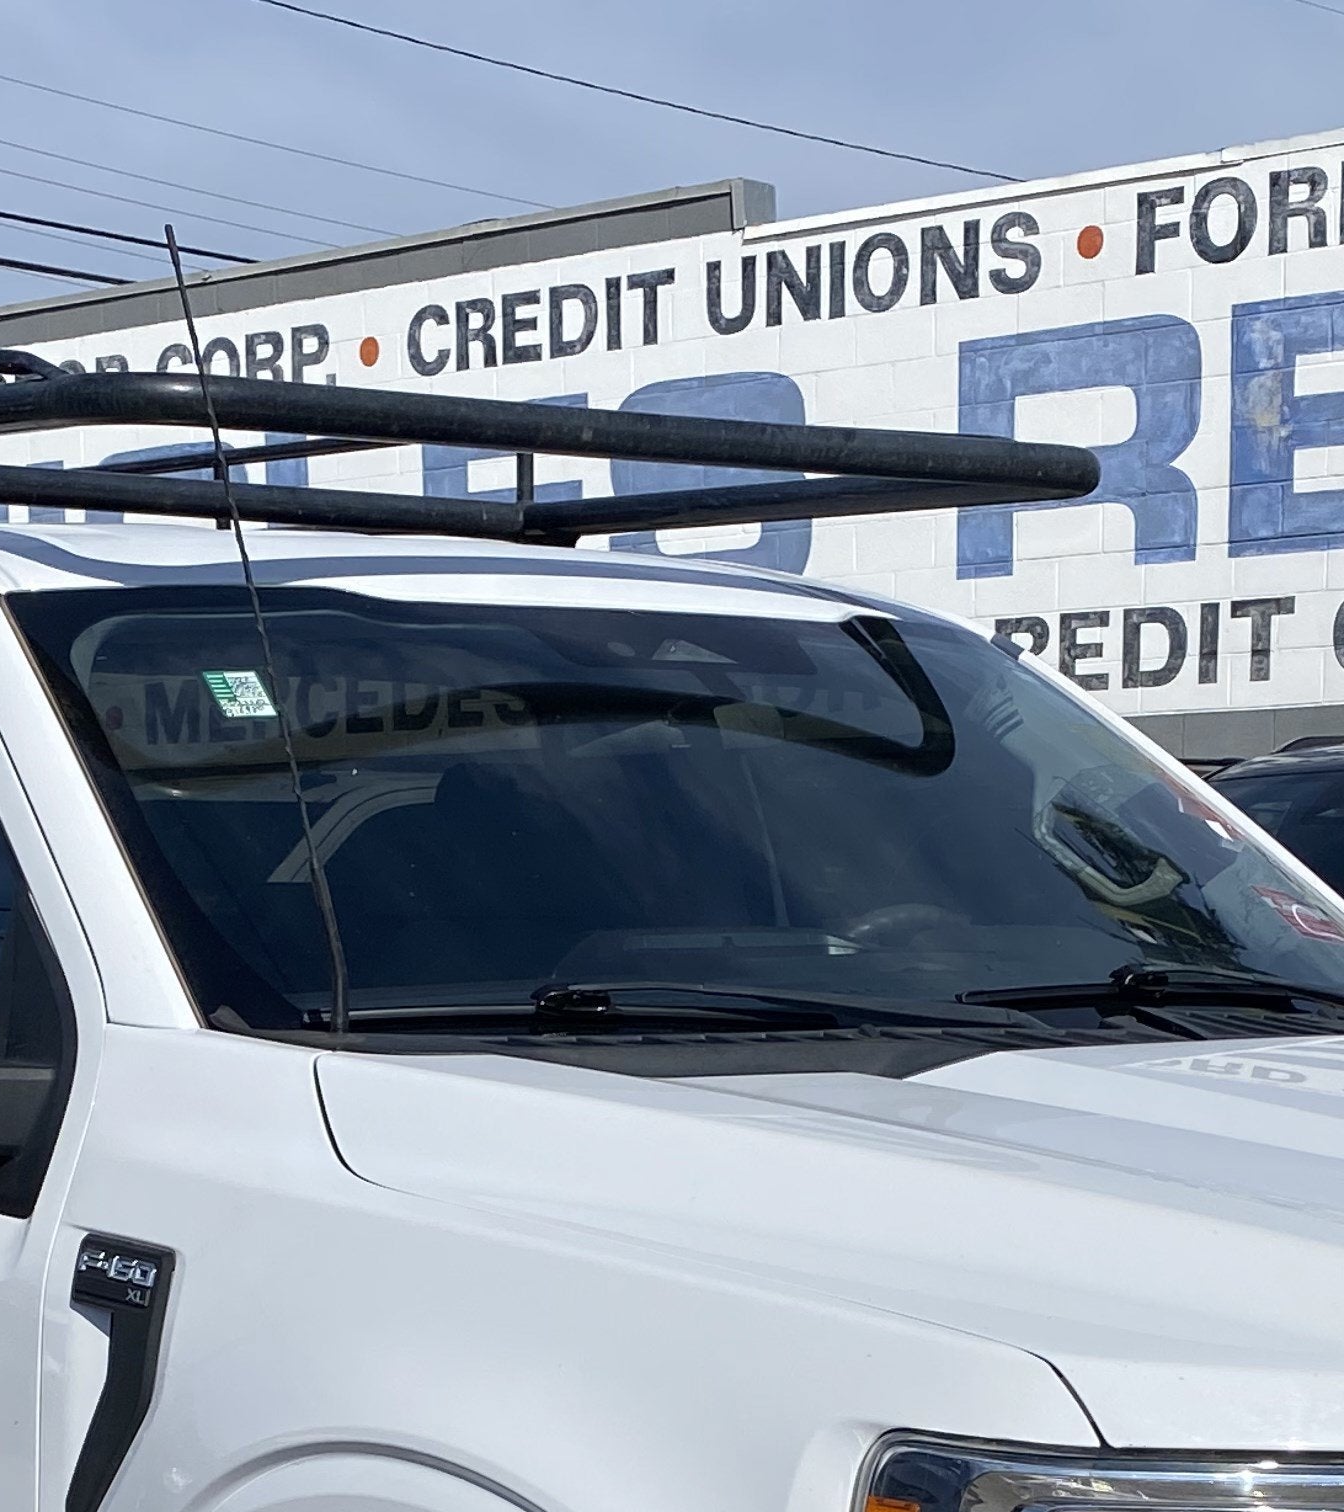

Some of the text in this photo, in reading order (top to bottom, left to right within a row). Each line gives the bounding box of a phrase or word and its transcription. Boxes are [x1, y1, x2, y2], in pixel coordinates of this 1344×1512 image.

[407, 267, 675, 376] CREDIT
[706, 211, 1042, 336] UNIONS
[144, 674, 529, 745] MECEDES
[77, 1250, 157, 1288] F-150
